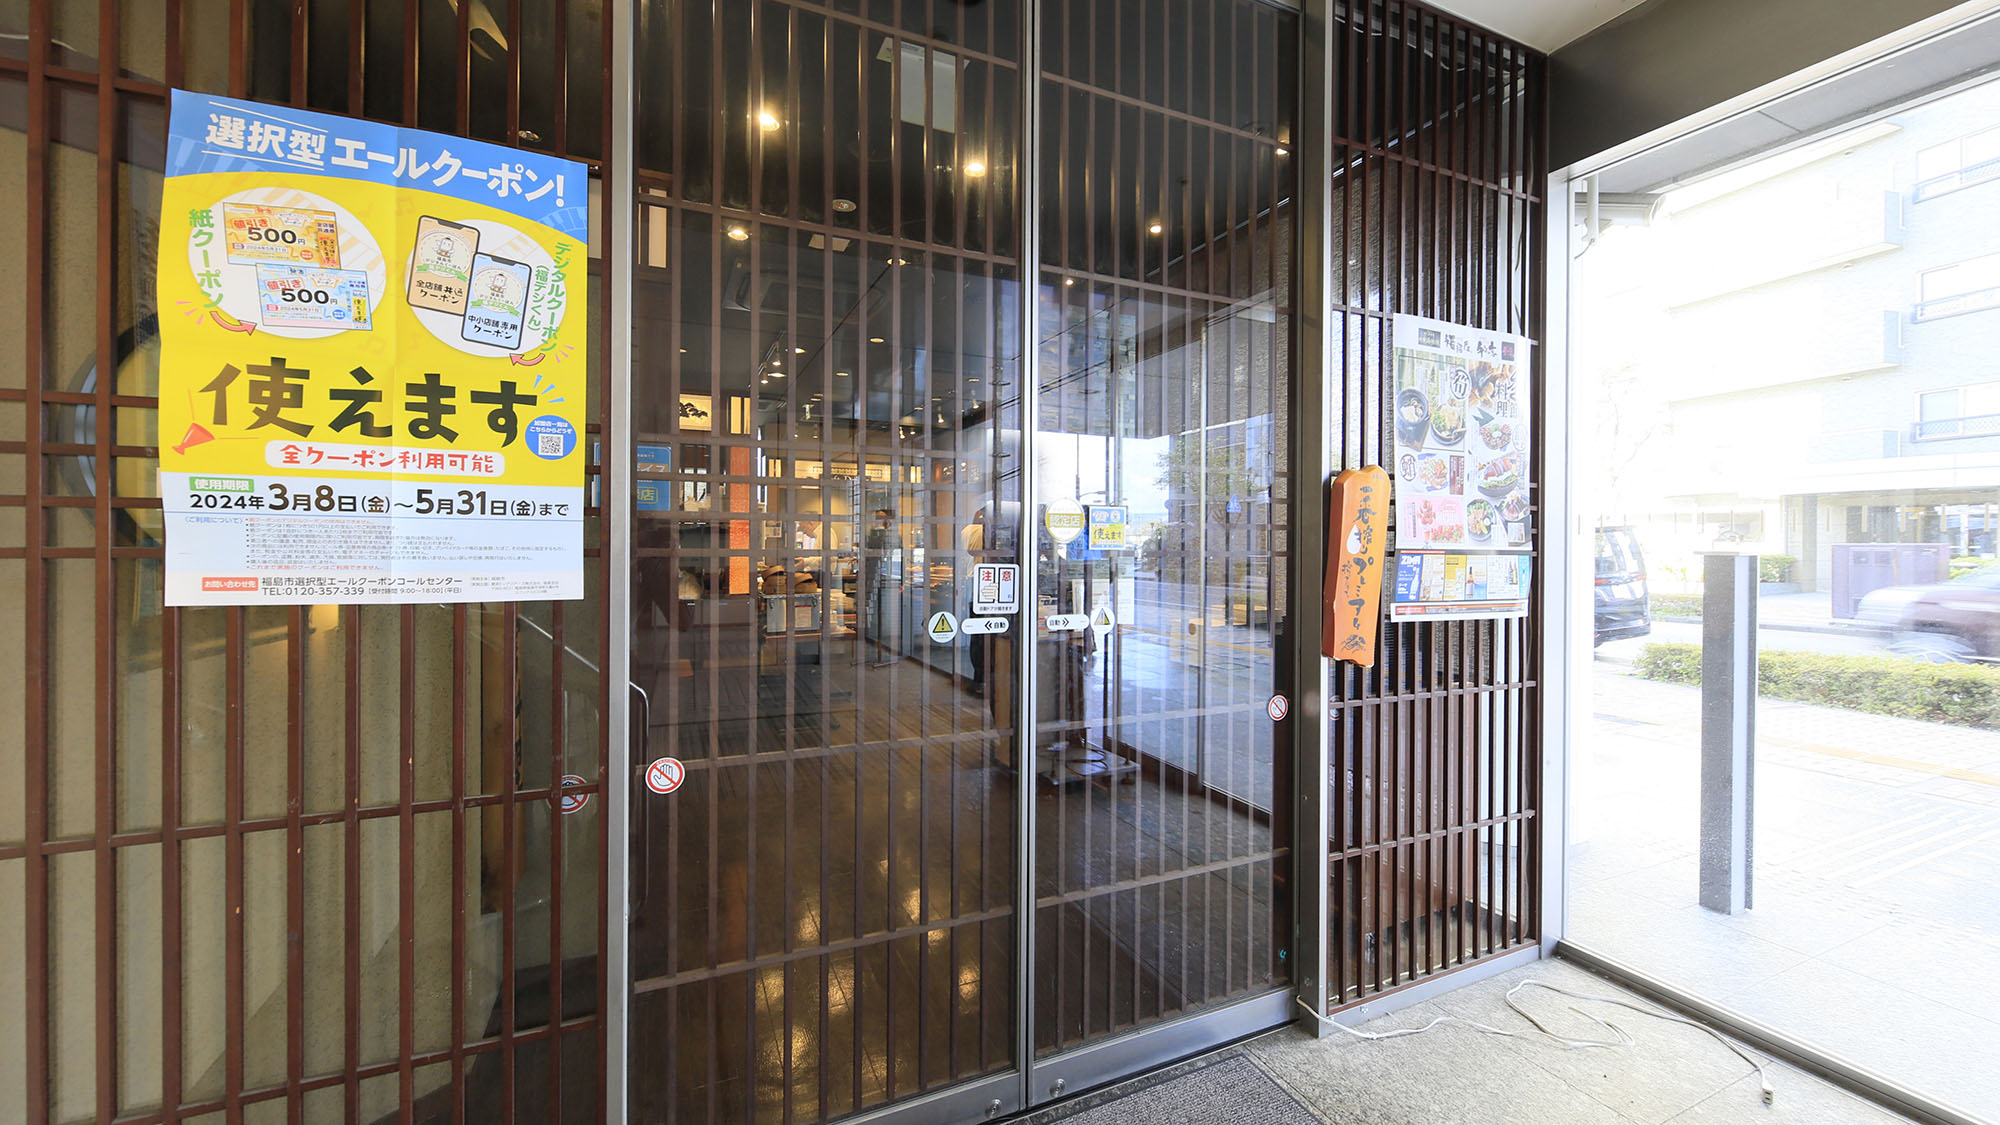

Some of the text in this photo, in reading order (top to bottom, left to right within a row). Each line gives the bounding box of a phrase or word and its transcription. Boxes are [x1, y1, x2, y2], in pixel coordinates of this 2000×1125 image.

[233, 218, 268, 230] 値引き
[188, 208, 223, 309] 紙クーポン
[267, 279, 301, 290] 値引き
[420, 289, 460, 304] クーポン
[527, 264, 549, 332] (福デジくん)
[540, 242, 572, 351] デジタルクーポン
[473, 325, 513, 339] クーポン
[200, 357, 538, 447] 使えます
[530, 426, 573, 435] こちらからどうぞ
[279, 444, 495, 473] 全クーポン利用可能
[194, 478, 250, 491] 使用期限
[204, 579, 256, 588] お問い合わせ先
[262, 577, 462, 587] 福島市選択型エールクーポンコールセンター
[263, 587, 365, 596] TEL:0120-357-339
[993, 621, 1006, 629] 自動
